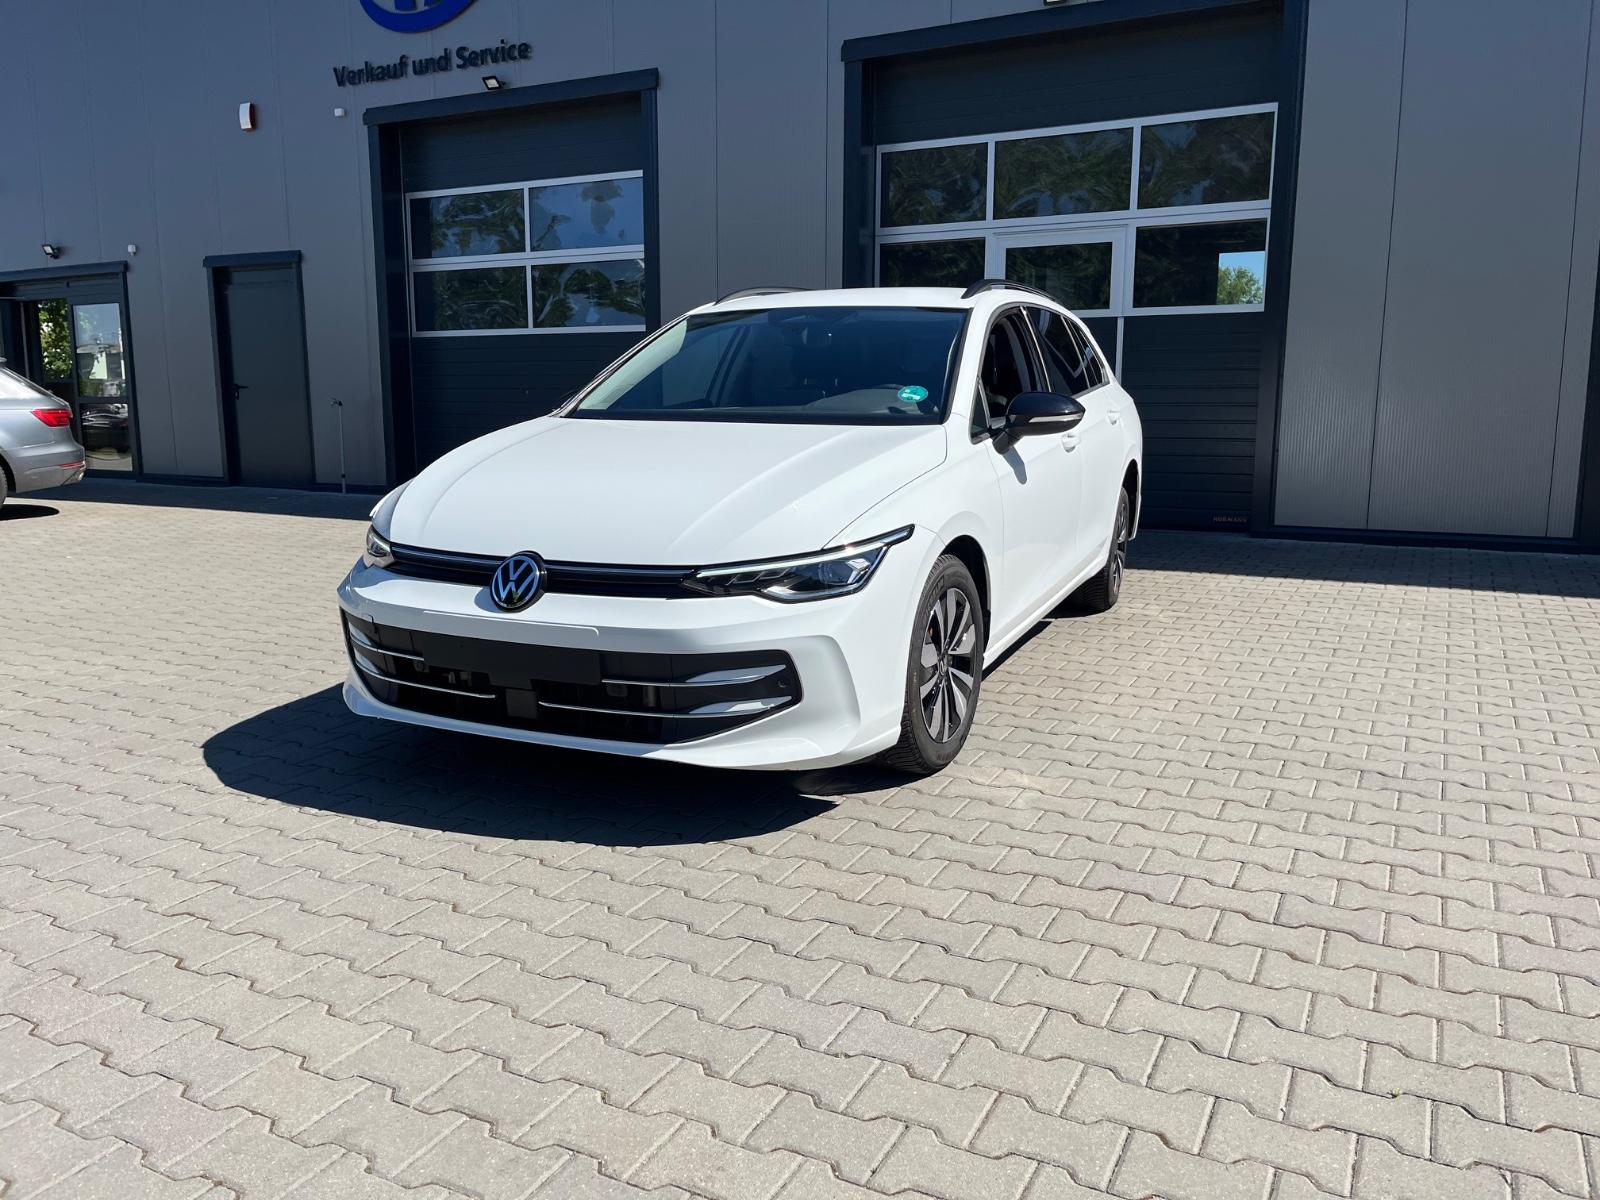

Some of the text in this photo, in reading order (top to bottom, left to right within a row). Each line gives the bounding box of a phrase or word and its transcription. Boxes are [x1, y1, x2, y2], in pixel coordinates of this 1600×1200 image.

[333, 39, 531, 87] Verkauf und Service
[494, 556, 539, 606] VW
